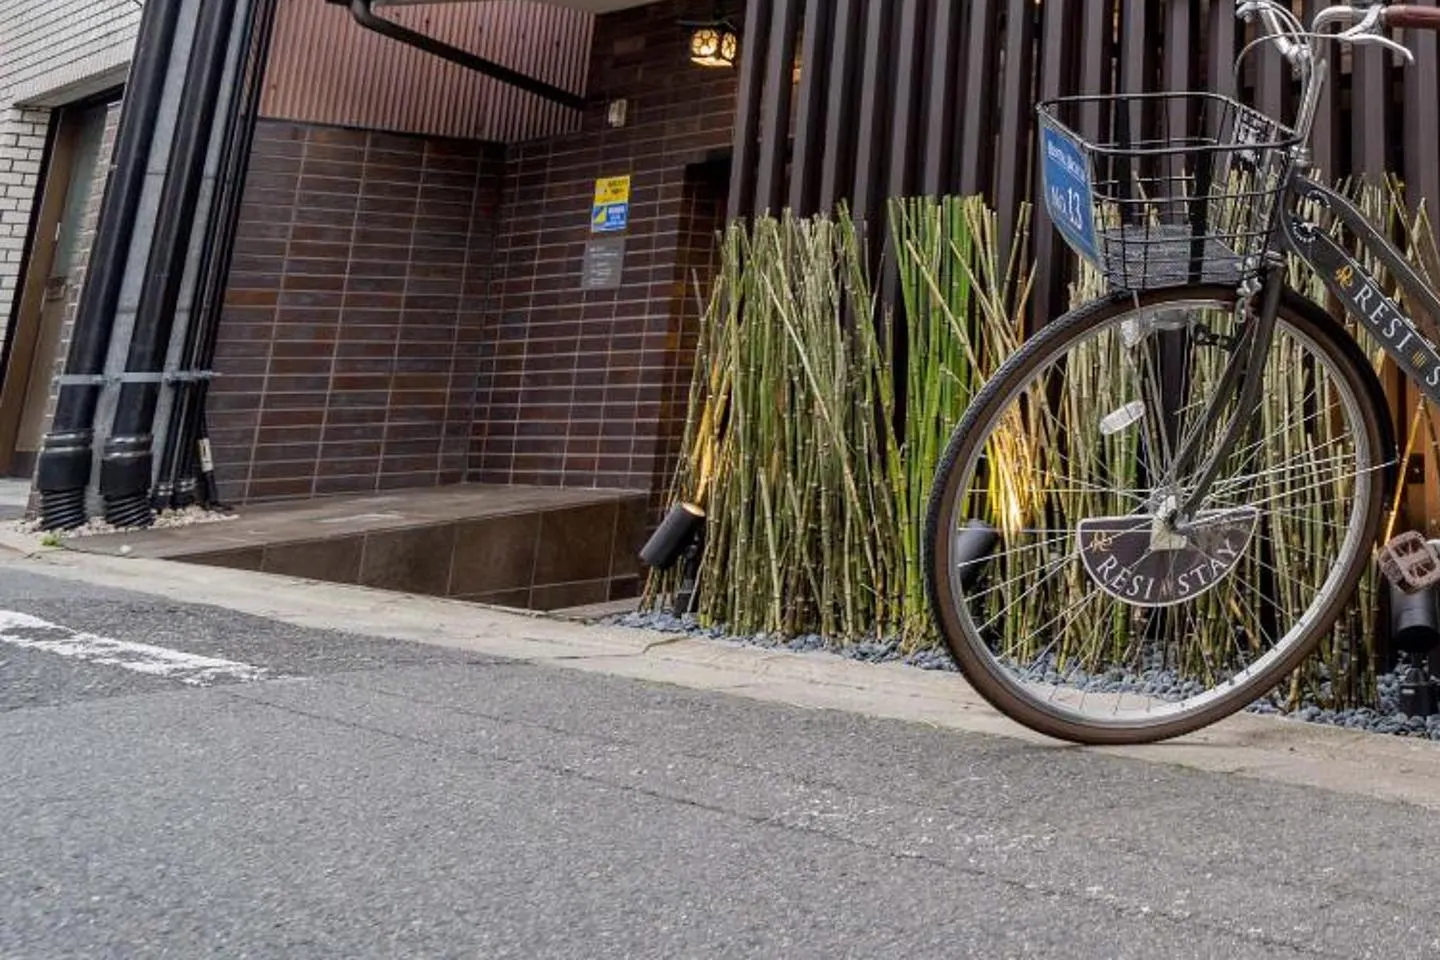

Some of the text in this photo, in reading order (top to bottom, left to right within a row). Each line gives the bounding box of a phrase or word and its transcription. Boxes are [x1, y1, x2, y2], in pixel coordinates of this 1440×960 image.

[1353, 284, 1414, 353] RESI
[1096, 538, 1238, 600] RESI STAY
